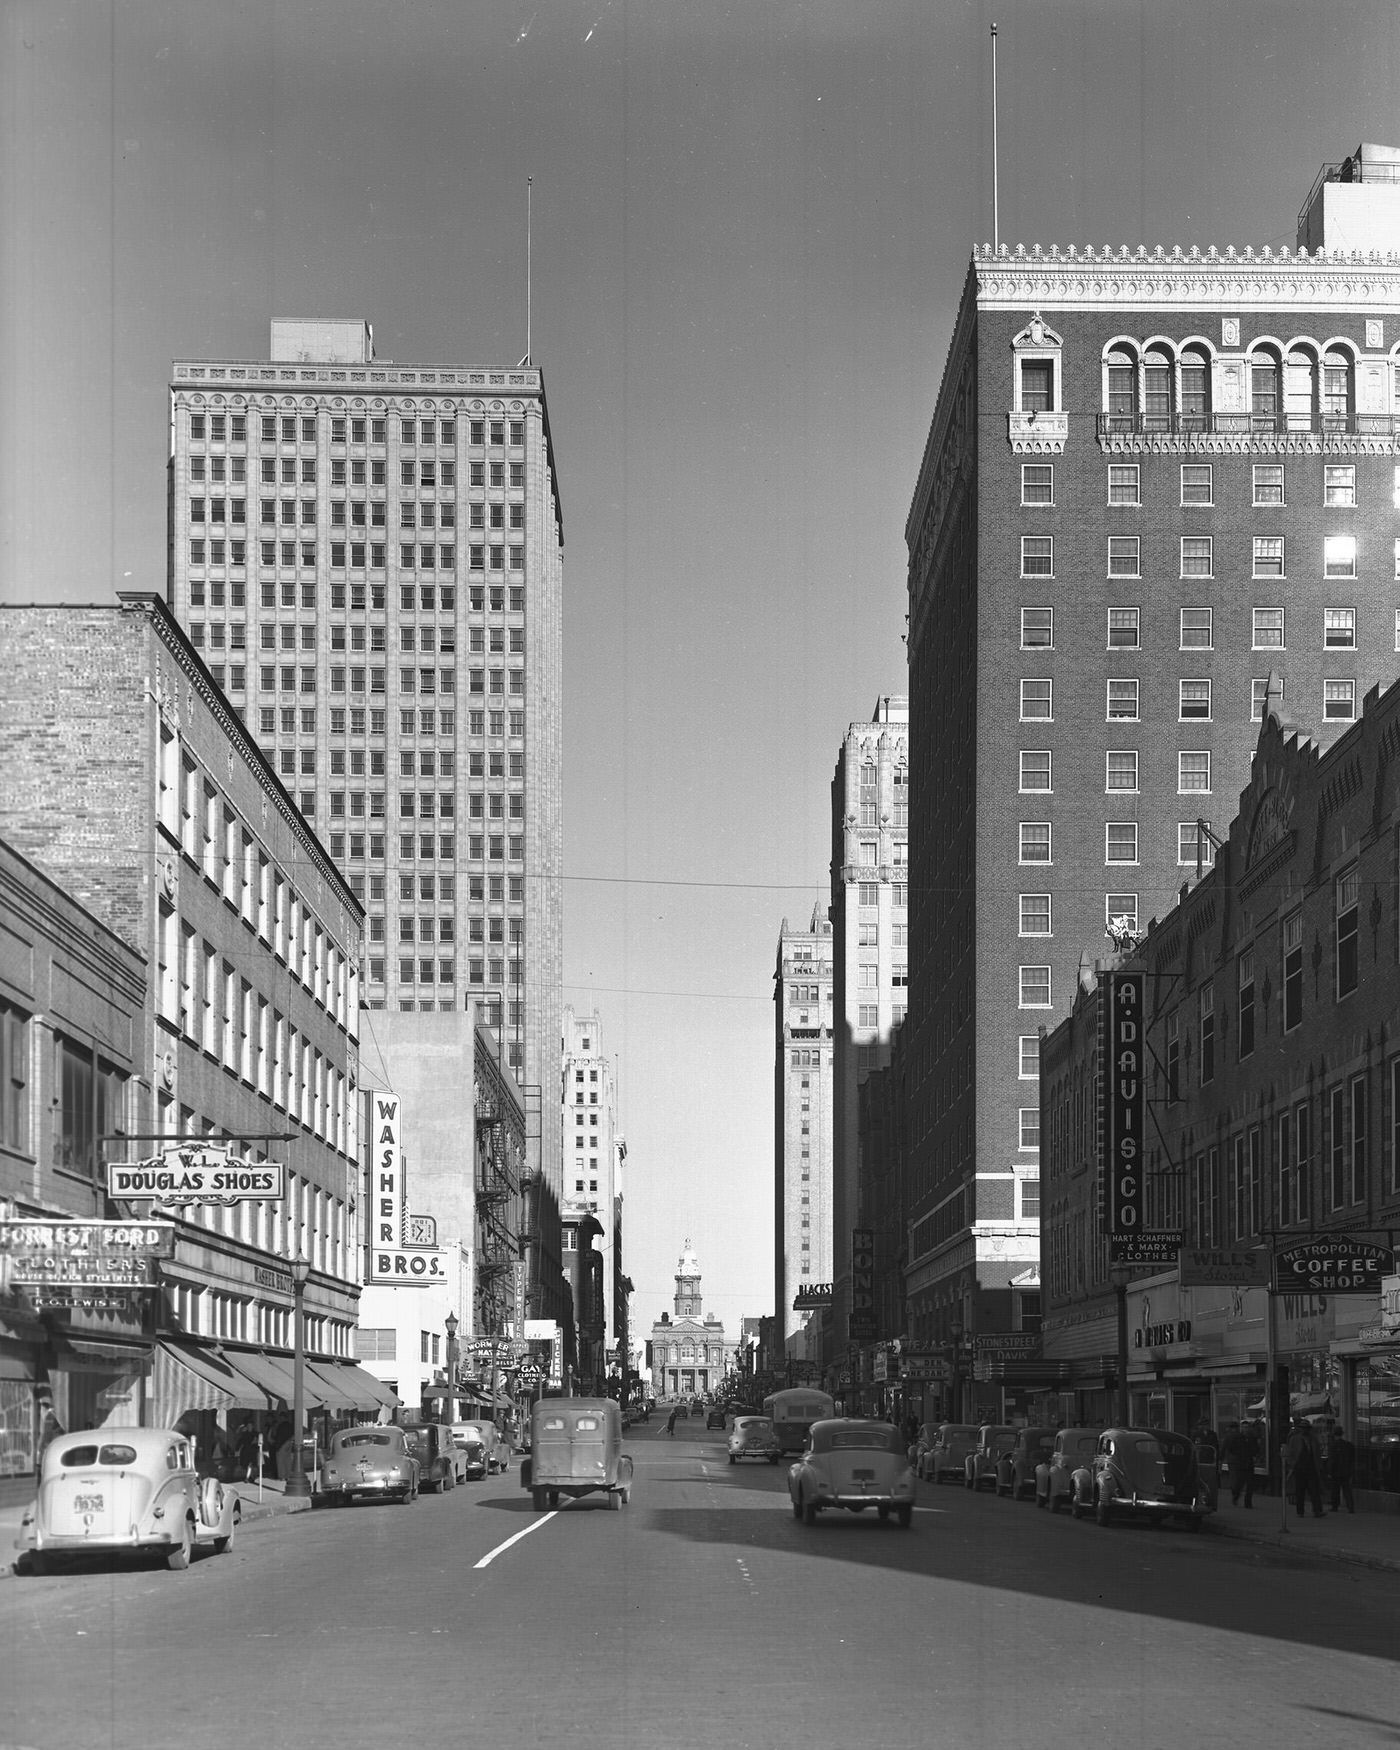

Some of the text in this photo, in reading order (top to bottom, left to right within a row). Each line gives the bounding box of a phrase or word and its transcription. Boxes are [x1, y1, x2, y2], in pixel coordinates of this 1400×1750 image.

[377, 1100, 397, 1242] WASHER
[116, 1172, 275, 1191] DOUGLAS SHOES
[103, 1228, 160, 1246] FORD
[1112, 1234, 1182, 1242] HART SCHAFFNER
[1127, 1243, 1168, 1251] & MARX
[1282, 1244, 1387, 1263] METROPOLITAN
[1117, 1252, 1178, 1261] CLOTHES
[1192, 1252, 1257, 1268] WILLS
[14, 1257, 147, 1272] CLOTHIERS
[377, 1254, 445, 1275] BROS.
[854, 1232, 873, 1310] BOND
[1292, 1259, 1379, 1274] COFFEE
[1308, 1274, 1366, 1289] SHOP
[1284, 1295, 1327, 1321] WILLS
[466, 1340, 509, 1352] WORMER
[975, 1336, 1036, 1348] STONESTREET
[554, 1329, 562, 1378] CHICKEN
[997, 1350, 1028, 1361] DAVIS
